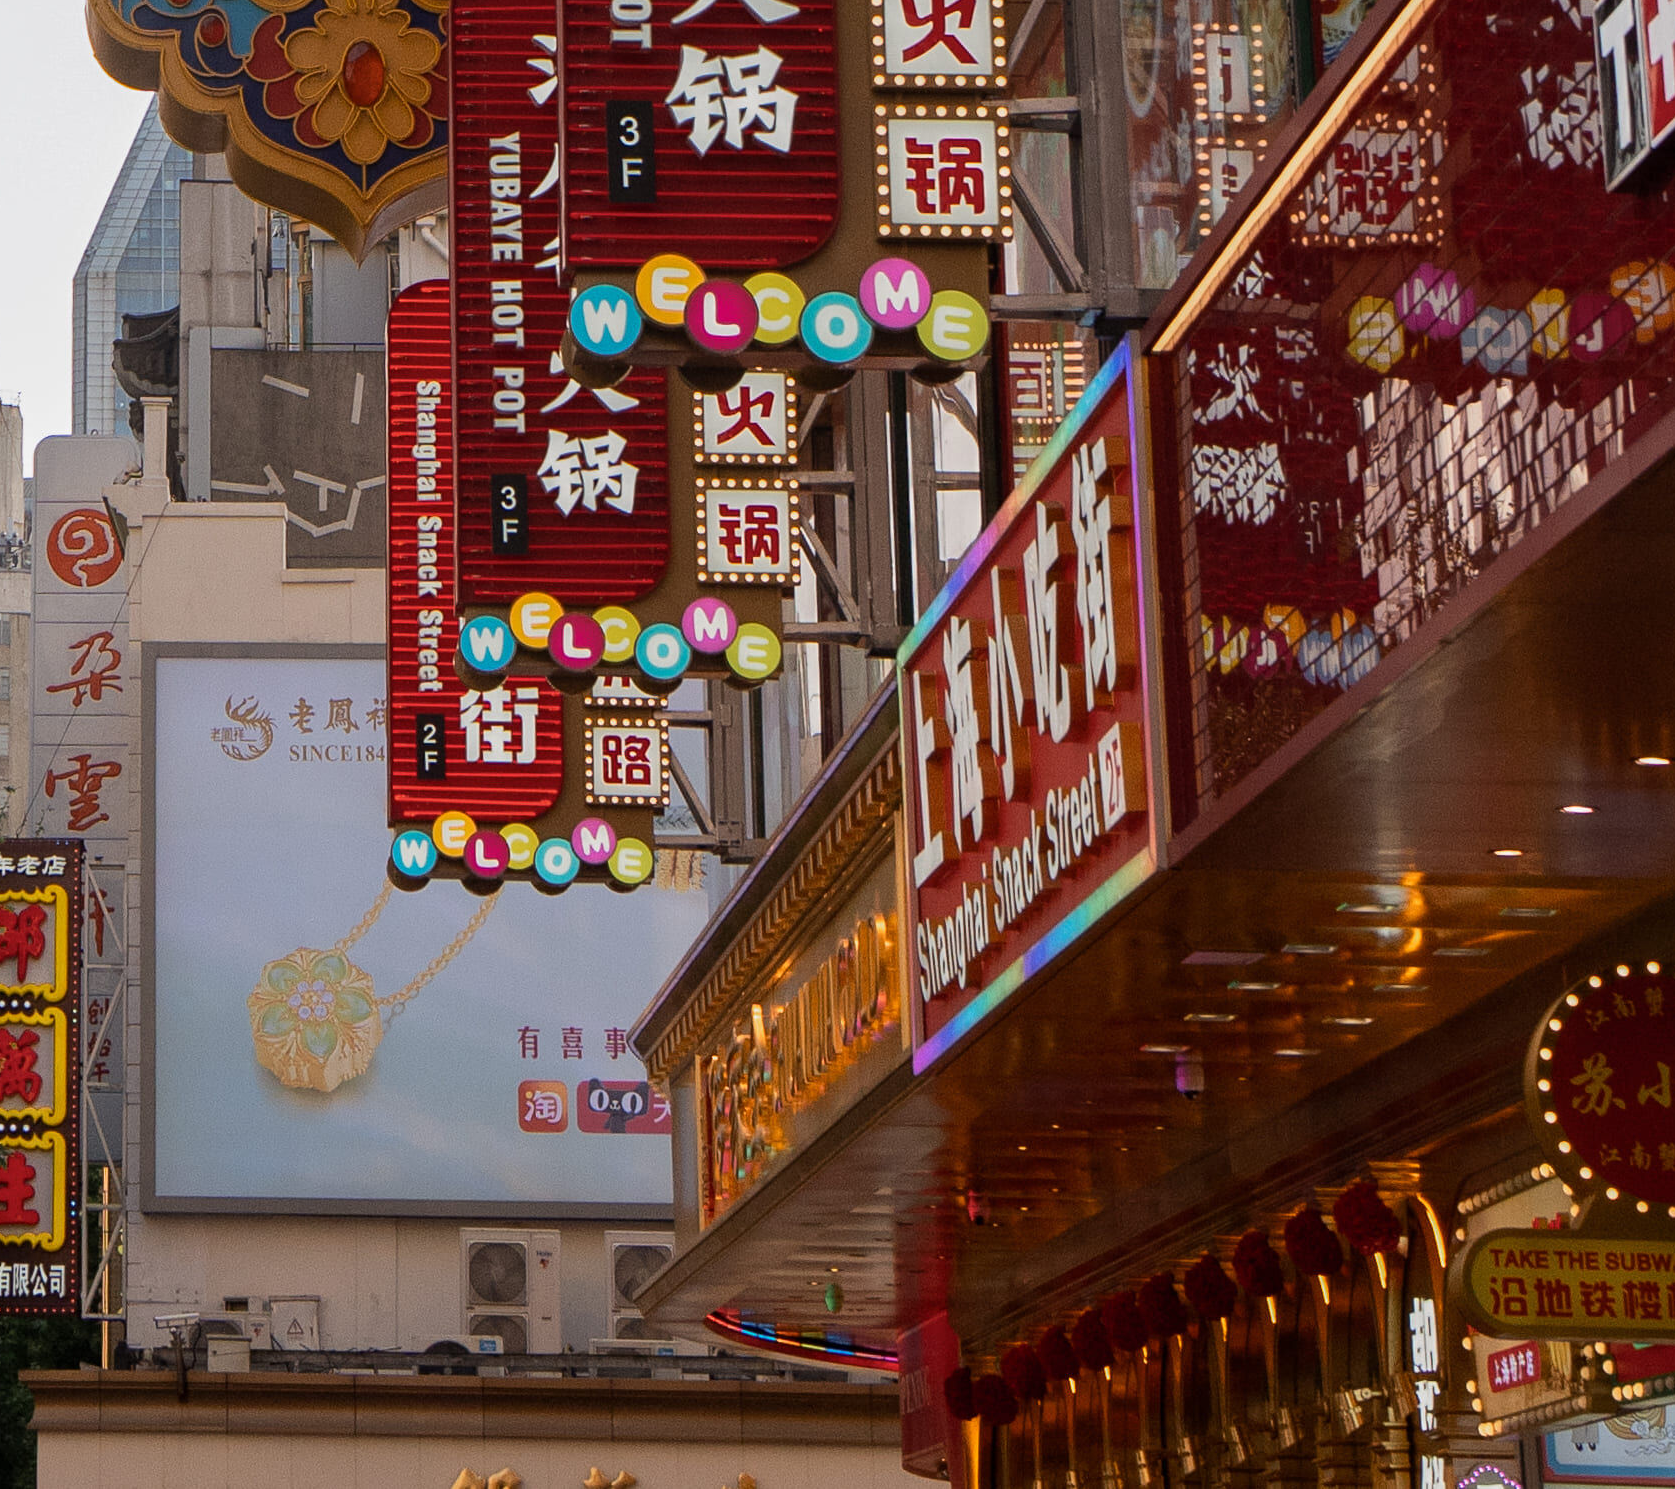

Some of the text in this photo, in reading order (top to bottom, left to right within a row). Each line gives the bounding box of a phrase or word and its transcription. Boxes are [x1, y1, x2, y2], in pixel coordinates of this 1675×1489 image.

[487, 131, 527, 435] YUBAYE HOT POT
[580, 265, 972, 351] WELCOME
[412, 379, 444, 692] Shanghai Snack Street
[468, 601, 772, 672] WELCOME
[913, 436, 1112, 889] 上海小吃街
[400, 817, 643, 879] WELCOME
[916, 751, 1100, 1004] Shanghai Snack Street
[517, 1025, 628, 1060] 有喜事
[523, 1090, 563, 1125] 淘
[1489, 1248, 1549, 1270] TAKE
[1553, 1250, 1601, 1272] THE
